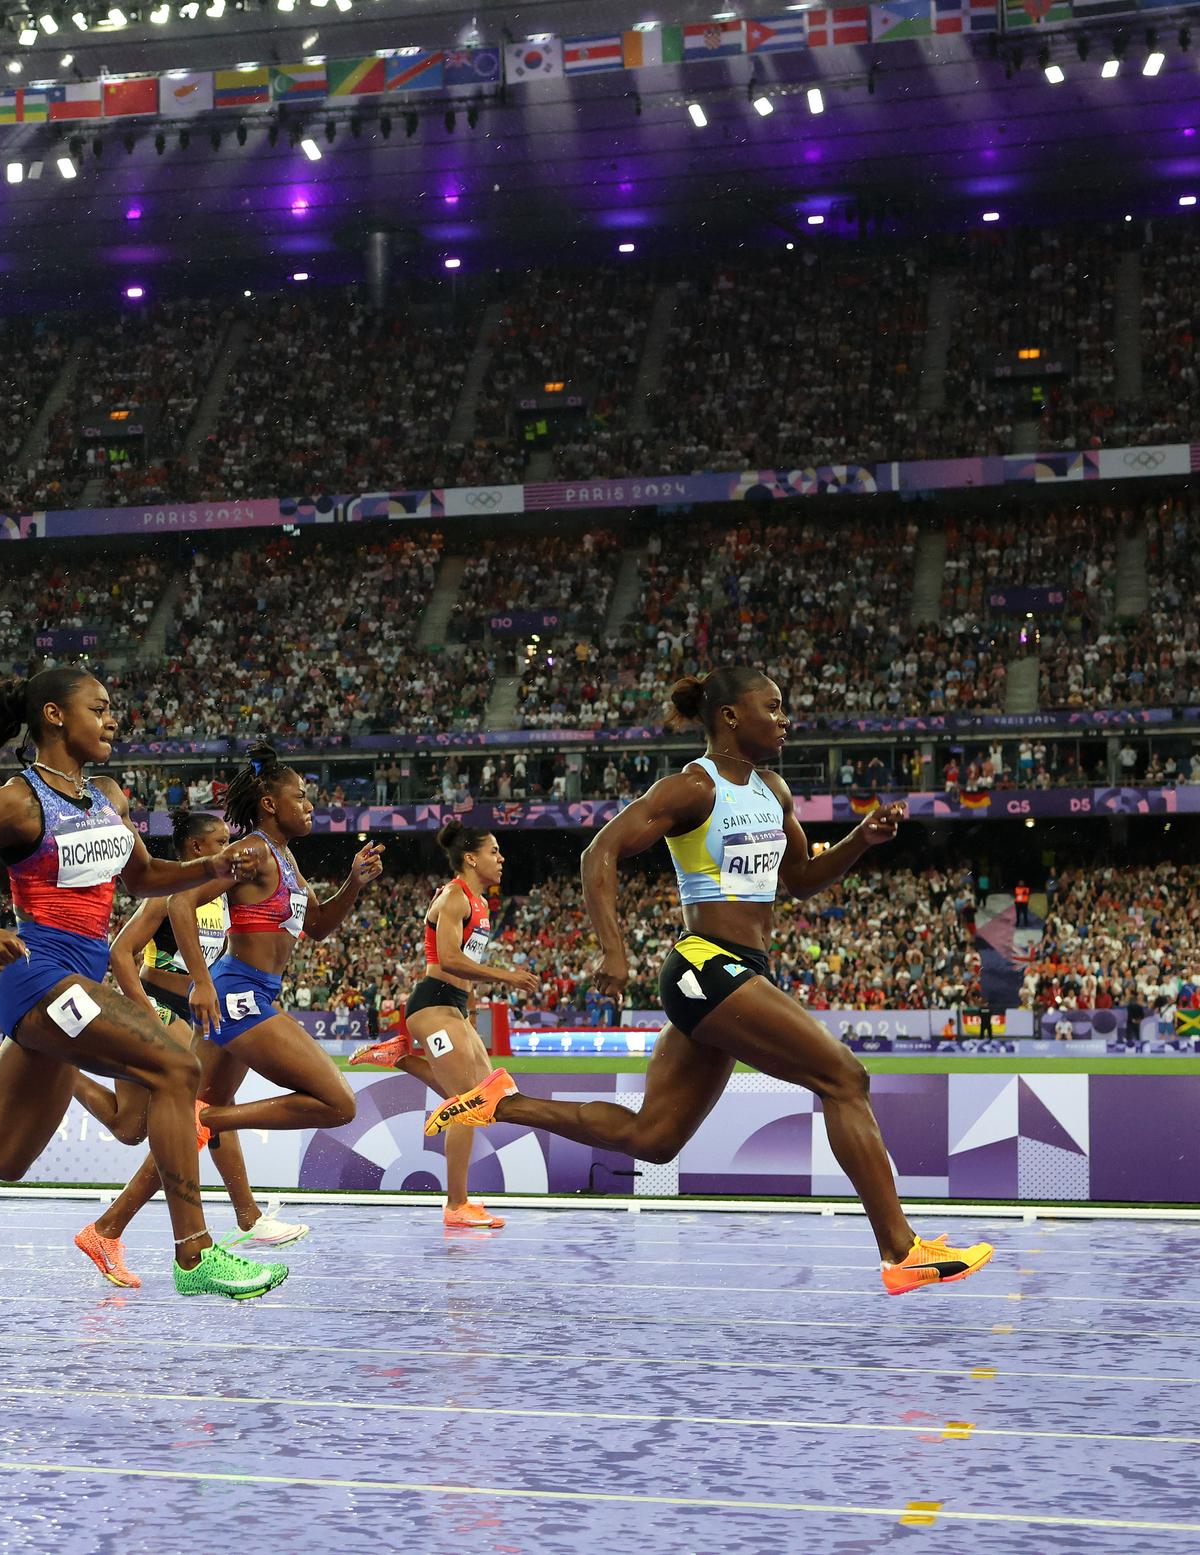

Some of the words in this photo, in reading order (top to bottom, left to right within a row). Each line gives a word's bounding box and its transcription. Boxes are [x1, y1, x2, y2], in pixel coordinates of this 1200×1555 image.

[632, 482, 685, 498] 2024
[205, 508, 254, 522] 2024
[1070, 798, 1091, 811] D5
[723, 814, 752, 829] SAINT
[729, 851, 780, 875] ALFRED
[60, 997, 84, 1021] 7
[235, 999, 251, 1017] 5
[434, 1037, 446, 1052] 2
[440, 1094, 487, 1121] NITRO
